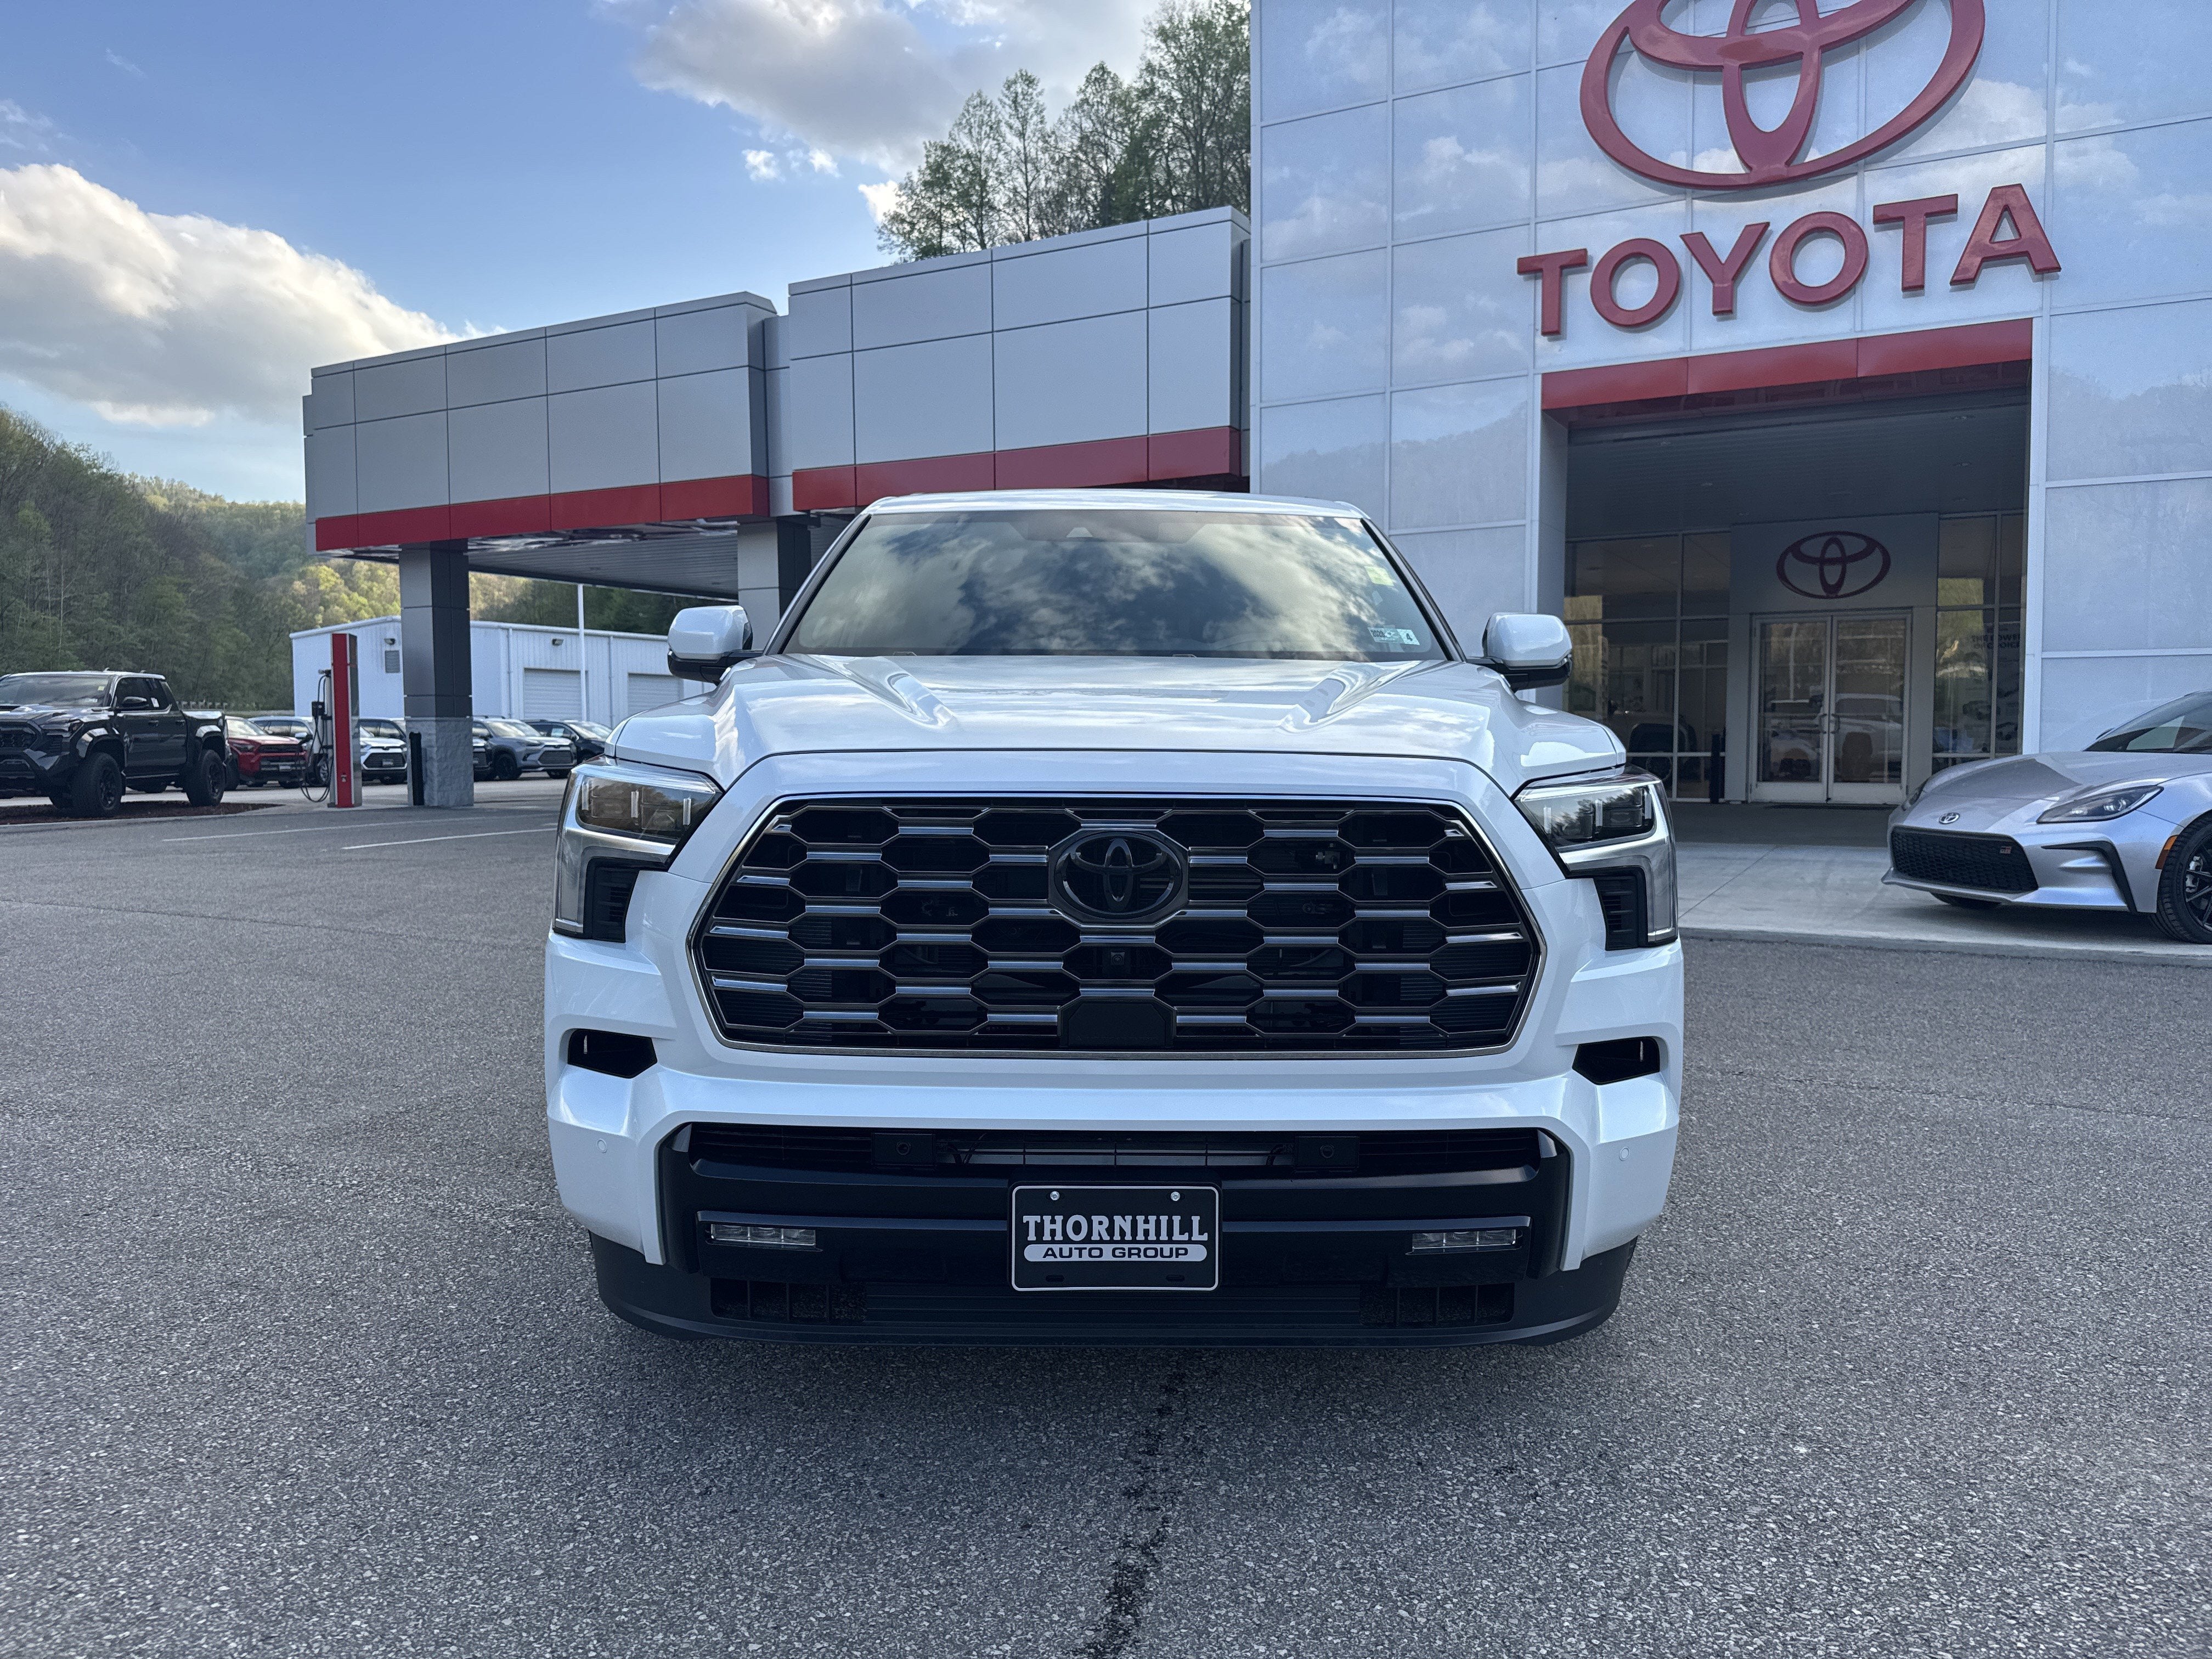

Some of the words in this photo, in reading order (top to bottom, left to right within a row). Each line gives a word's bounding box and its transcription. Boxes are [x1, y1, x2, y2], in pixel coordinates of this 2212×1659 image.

[1517, 183, 2061, 336] TOYOTA
[1406, 633, 1412, 641] 4
[1023, 1214, 1208, 1242] THORNHILL
[1042, 1247, 1104, 1259] AUTO
[1111, 1247, 1189, 1259] GROUP
